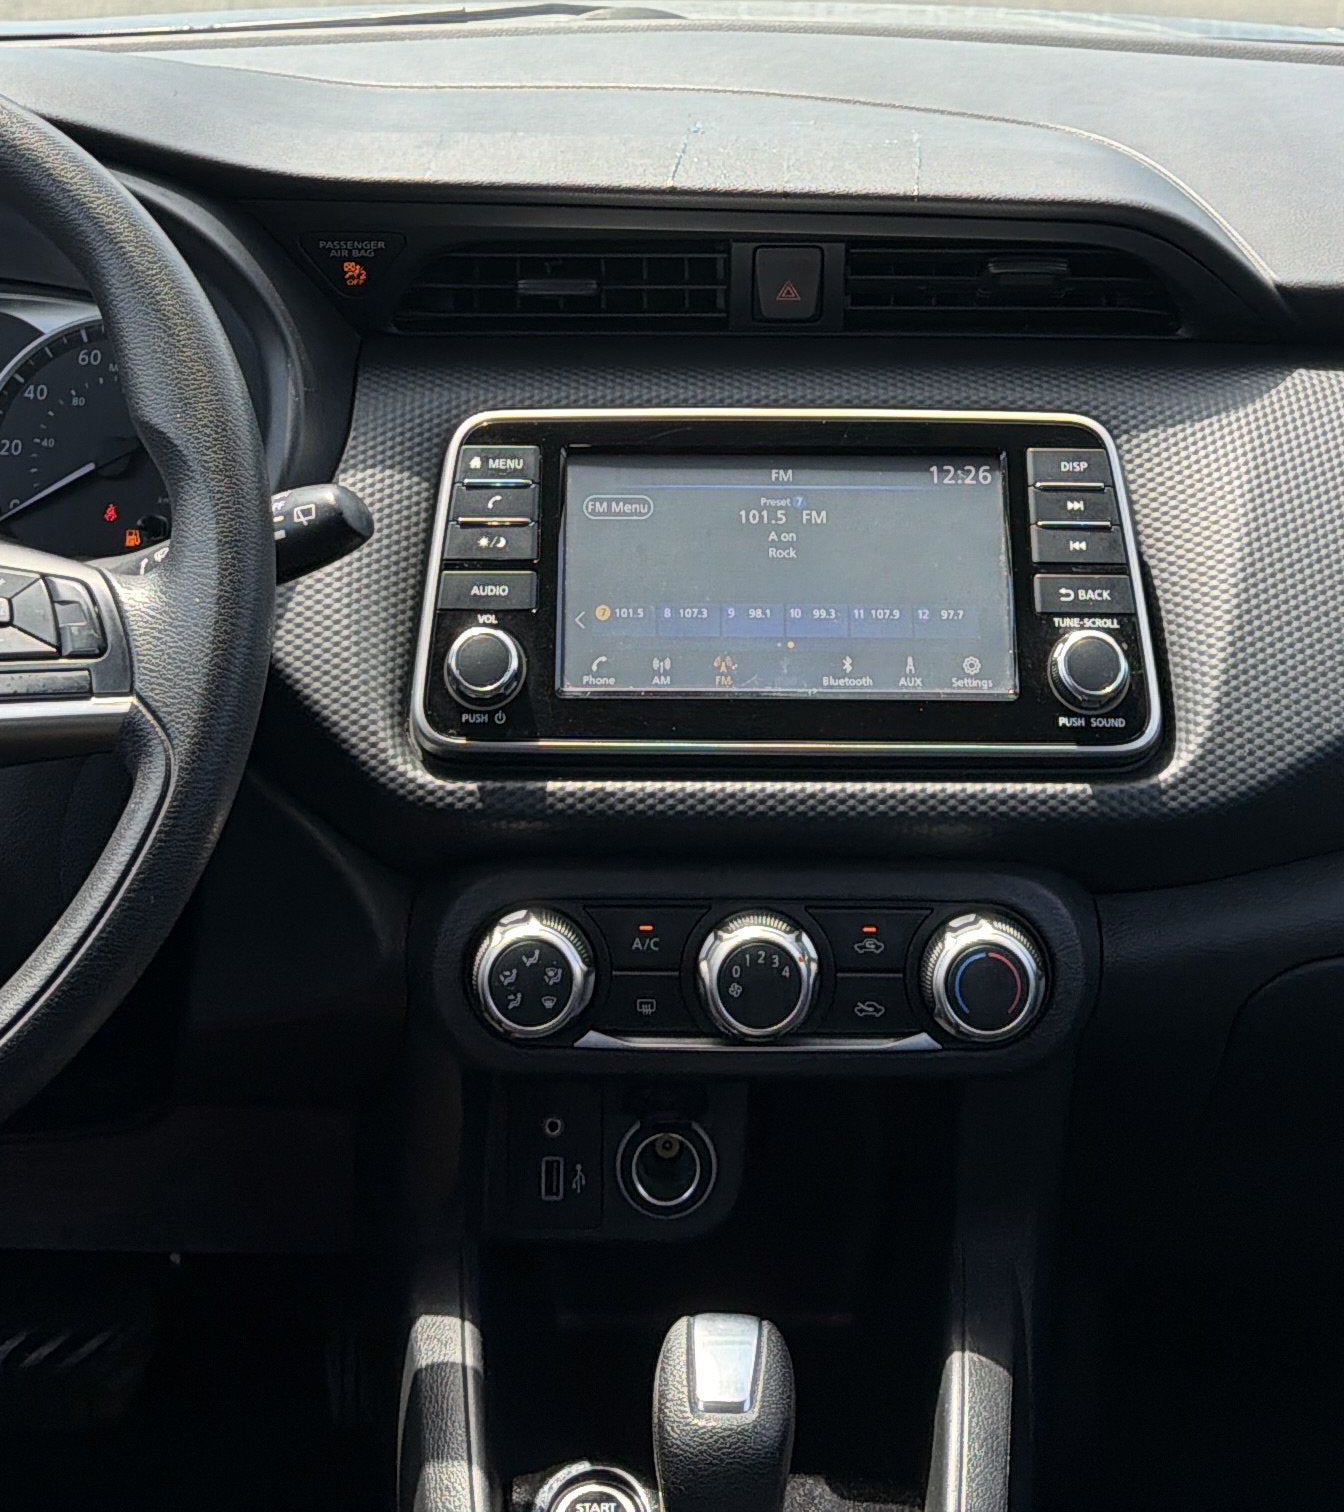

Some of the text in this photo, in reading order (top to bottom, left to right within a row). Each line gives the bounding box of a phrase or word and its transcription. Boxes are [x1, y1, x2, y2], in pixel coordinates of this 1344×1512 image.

[319, 241, 386, 249] PASSENGER
[78, 349, 102, 365] 60
[24, 385, 48, 400] 40
[72, 397, 85, 406] 80
[0, 440, 22, 456] 20
[41, 439, 55, 448] 40
[488, 458, 523, 470] MENU
[1060, 462, 1088, 472] DISP
[771, 470, 793, 482] FM
[930, 466, 992, 485] 12:26
[588, 502, 648, 513] FM Menu
[760, 497, 803, 507] Preset 7
[739, 510, 827, 524] 101.5 FM
[769, 547, 797, 558] Rock
[470, 586, 508, 596] AUDIO
[1078, 590, 1111, 601] BACK
[477, 614, 497, 624] VOL
[615, 608, 644, 618] 101.5
[664, 608, 671, 618] 8
[679, 608, 707, 618] 107.3
[728, 608, 735, 618] 9
[748, 608, 771, 618] 98.1
[790, 609, 801, 618] 10
[813, 609, 836, 619] 99.3
[854, 609, 864, 619] 11
[871, 610, 900, 619] 107.9
[918, 610, 929, 619] 12
[941, 610, 964, 619] 97.7
[583, 676, 615, 685] Phone
[653, 676, 670, 685] AM
[716, 676, 733, 685] FM
[822, 677, 873, 686] Bluetooth
[899, 677, 922, 687] AUX
[951, 677, 993, 689] Settings
[462, 714, 488, 723] PUSH
[1058, 717, 1125, 728] PUSH SOUND
[632, 938, 659, 951] A/C
[745, 954, 750, 966] 1
[757, 951, 765, 964] 2
[772, 955, 779, 967] 3
[732, 965, 740, 978] 0
[781, 966, 790, 978] 4
[575, 1502, 617, 1512] START
